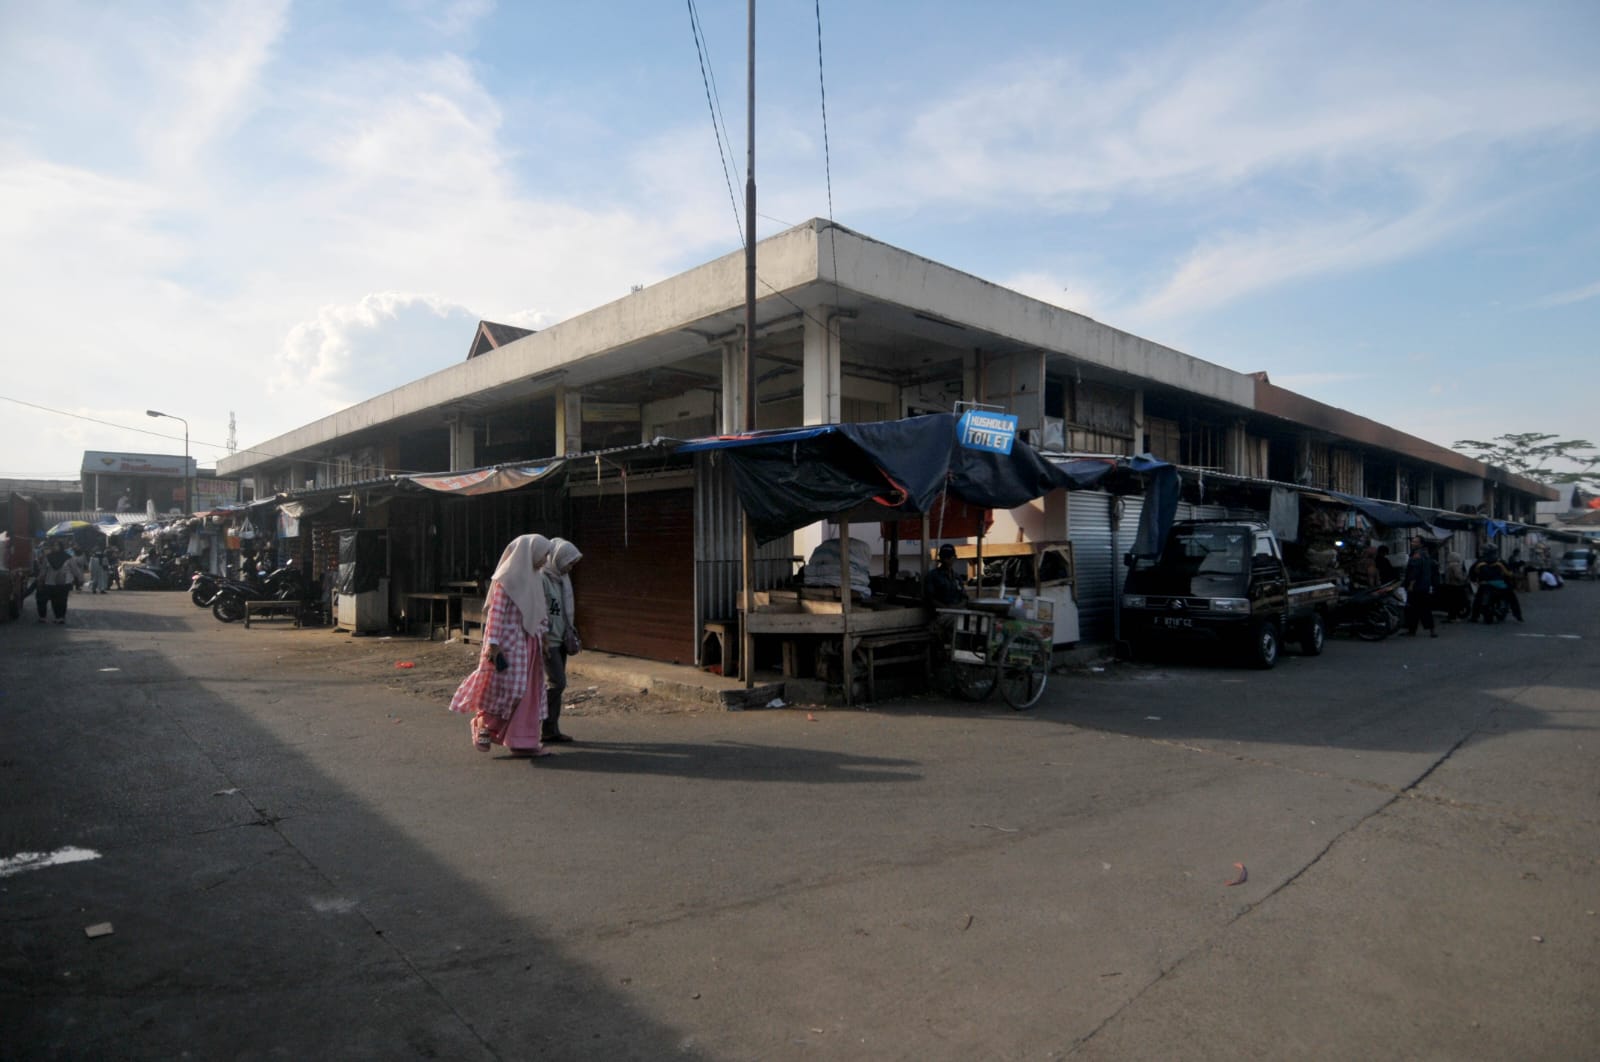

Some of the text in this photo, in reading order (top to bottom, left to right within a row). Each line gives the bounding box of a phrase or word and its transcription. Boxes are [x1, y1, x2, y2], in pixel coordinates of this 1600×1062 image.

[970, 415, 1014, 432] MUSHOLLA
[968, 430, 1010, 449] TOILET
[549, 598, 561, 616] LA
